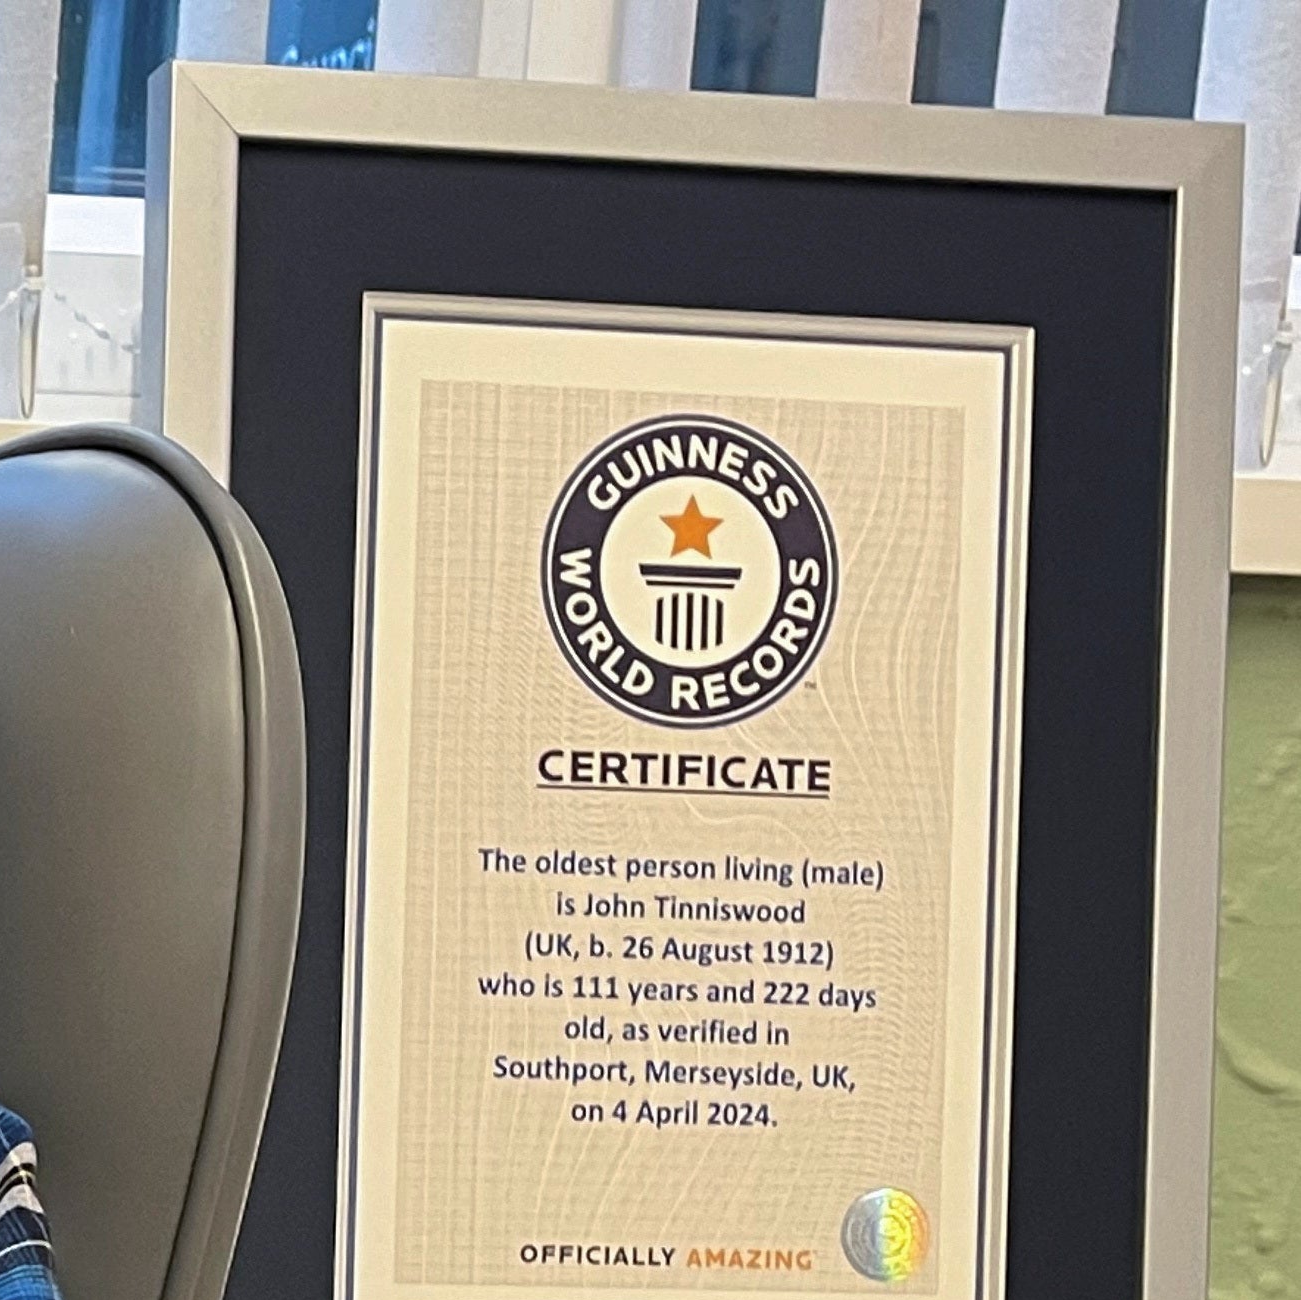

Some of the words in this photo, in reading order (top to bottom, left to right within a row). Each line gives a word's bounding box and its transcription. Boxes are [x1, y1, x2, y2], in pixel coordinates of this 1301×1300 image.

[587, 434, 800, 520] GUINNESS
[559, 548, 656, 698] WORLD
[670, 556, 821, 711] RECORDS
[538, 749, 833, 793] CERTIFICATE
[477, 847, 527, 874] The
[535, 848, 618, 878] oldest
[625, 858, 716, 884] person
[724, 854, 794, 889] living
[801, 857, 884, 893] (male)
[556, 890, 576, 917] is
[583, 892, 646, 919] John
[653, 894, 806, 925] Tinniswood
[525, 930, 580, 963] (UK,
[589, 932, 613, 959] b.
[622, 935, 654, 960] 26
[661, 936, 754, 968] August
[762, 940, 834, 972] 1912)
[477, 971, 536, 998] who
[543, 972, 564, 999] is
[572, 975, 619, 1000] 111
[627, 981, 699, 1007] years
[706, 978, 755, 1004] and
[763, 980, 810, 1006] 222
[818, 981, 877, 1013] days
[564, 1014, 614, 1045] old,
[621, 1022, 650, 1042] as
[657, 1018, 758, 1045] verified
[766, 1020, 790, 1046] in
[492, 1054, 636, 1087] Southport,
[645, 1059, 803, 1092] Merseyside,
[812, 1063, 856, 1094] UK,
[570, 1103, 604, 1123] on
[611, 1099, 627, 1123] 4
[635, 1099, 699, 1131] April
[707, 1102, 778, 1128] 2024.
[519, 1244, 677, 1268] OFFICIALLY
[685, 1247, 813, 1271] AMAZING
